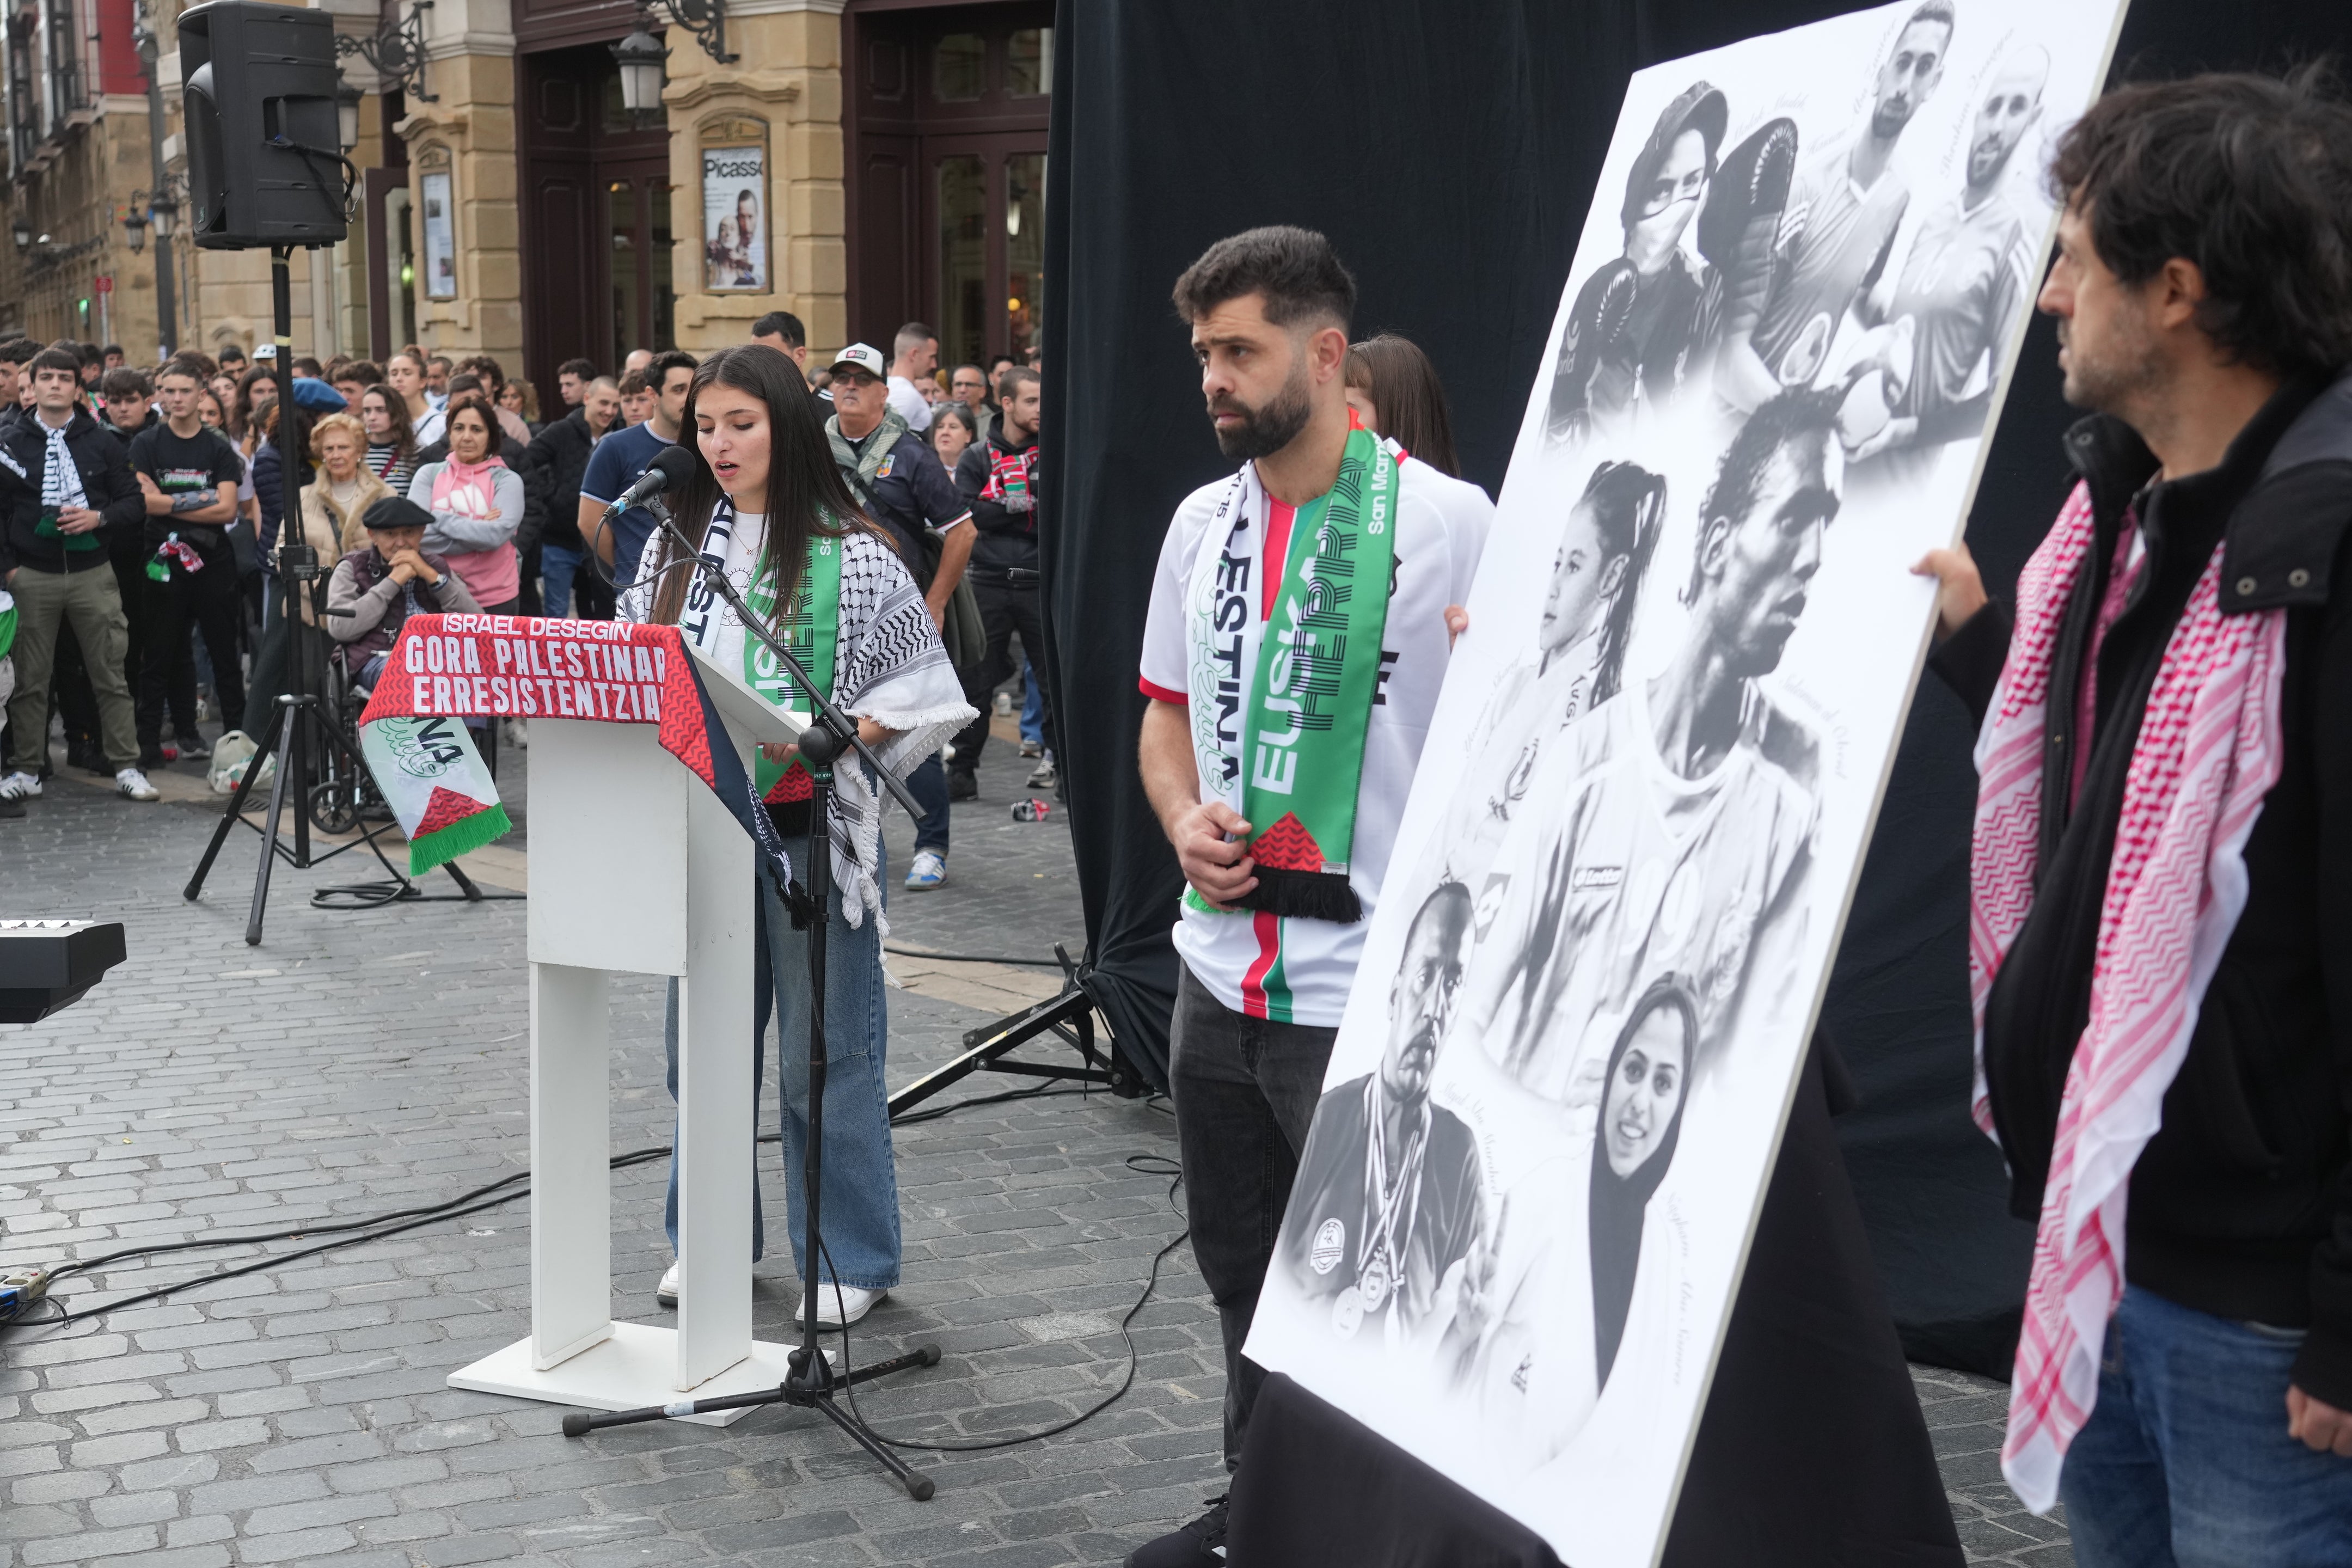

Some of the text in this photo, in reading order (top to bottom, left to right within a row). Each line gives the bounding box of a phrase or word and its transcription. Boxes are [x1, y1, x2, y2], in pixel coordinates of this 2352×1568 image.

[1368, 493, 1387, 535] San
[1286, 458, 1367, 731] HERRIA
[442, 614, 634, 642] ISRAEL DESEGIN
[405, 635, 482, 675] GORA
[413, 676, 664, 721] ERRESISTENTZIA
[827, 719, 844, 738] SENNHEISER
[1585, 868, 1621, 885] Lotto
[1619, 857, 1700, 961] 99
